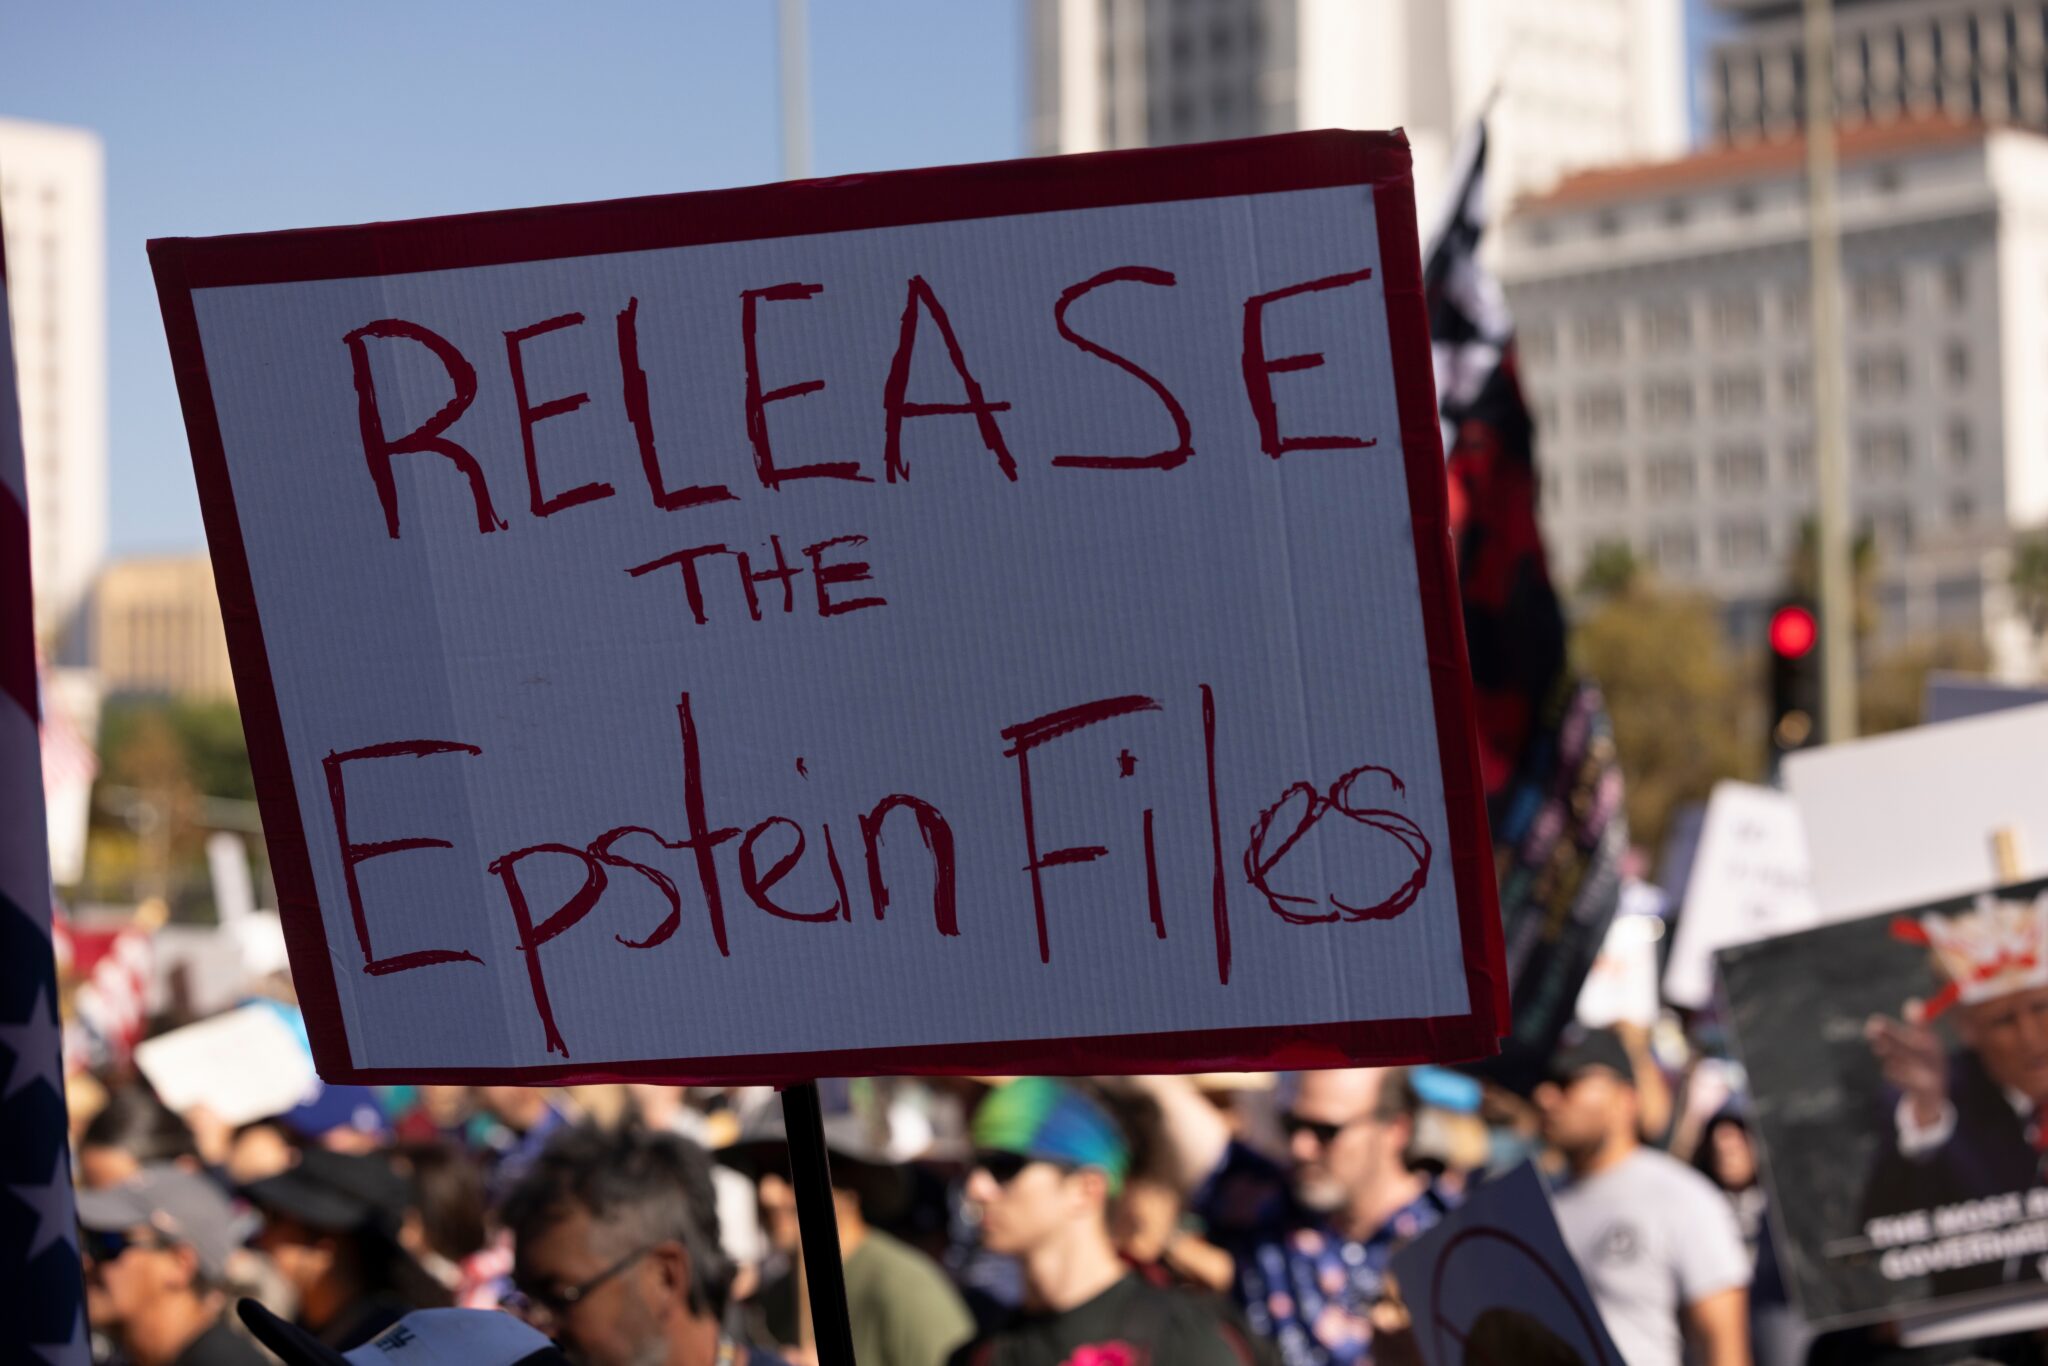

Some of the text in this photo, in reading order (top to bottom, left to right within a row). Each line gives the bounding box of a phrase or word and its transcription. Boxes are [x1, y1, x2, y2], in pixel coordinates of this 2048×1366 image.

[344, 265, 1377, 539] RELEASE
[627, 534, 887, 625] THE
[323, 684, 1432, 1058] Epstein Files
[1865, 1209, 1930, 1248] THE
